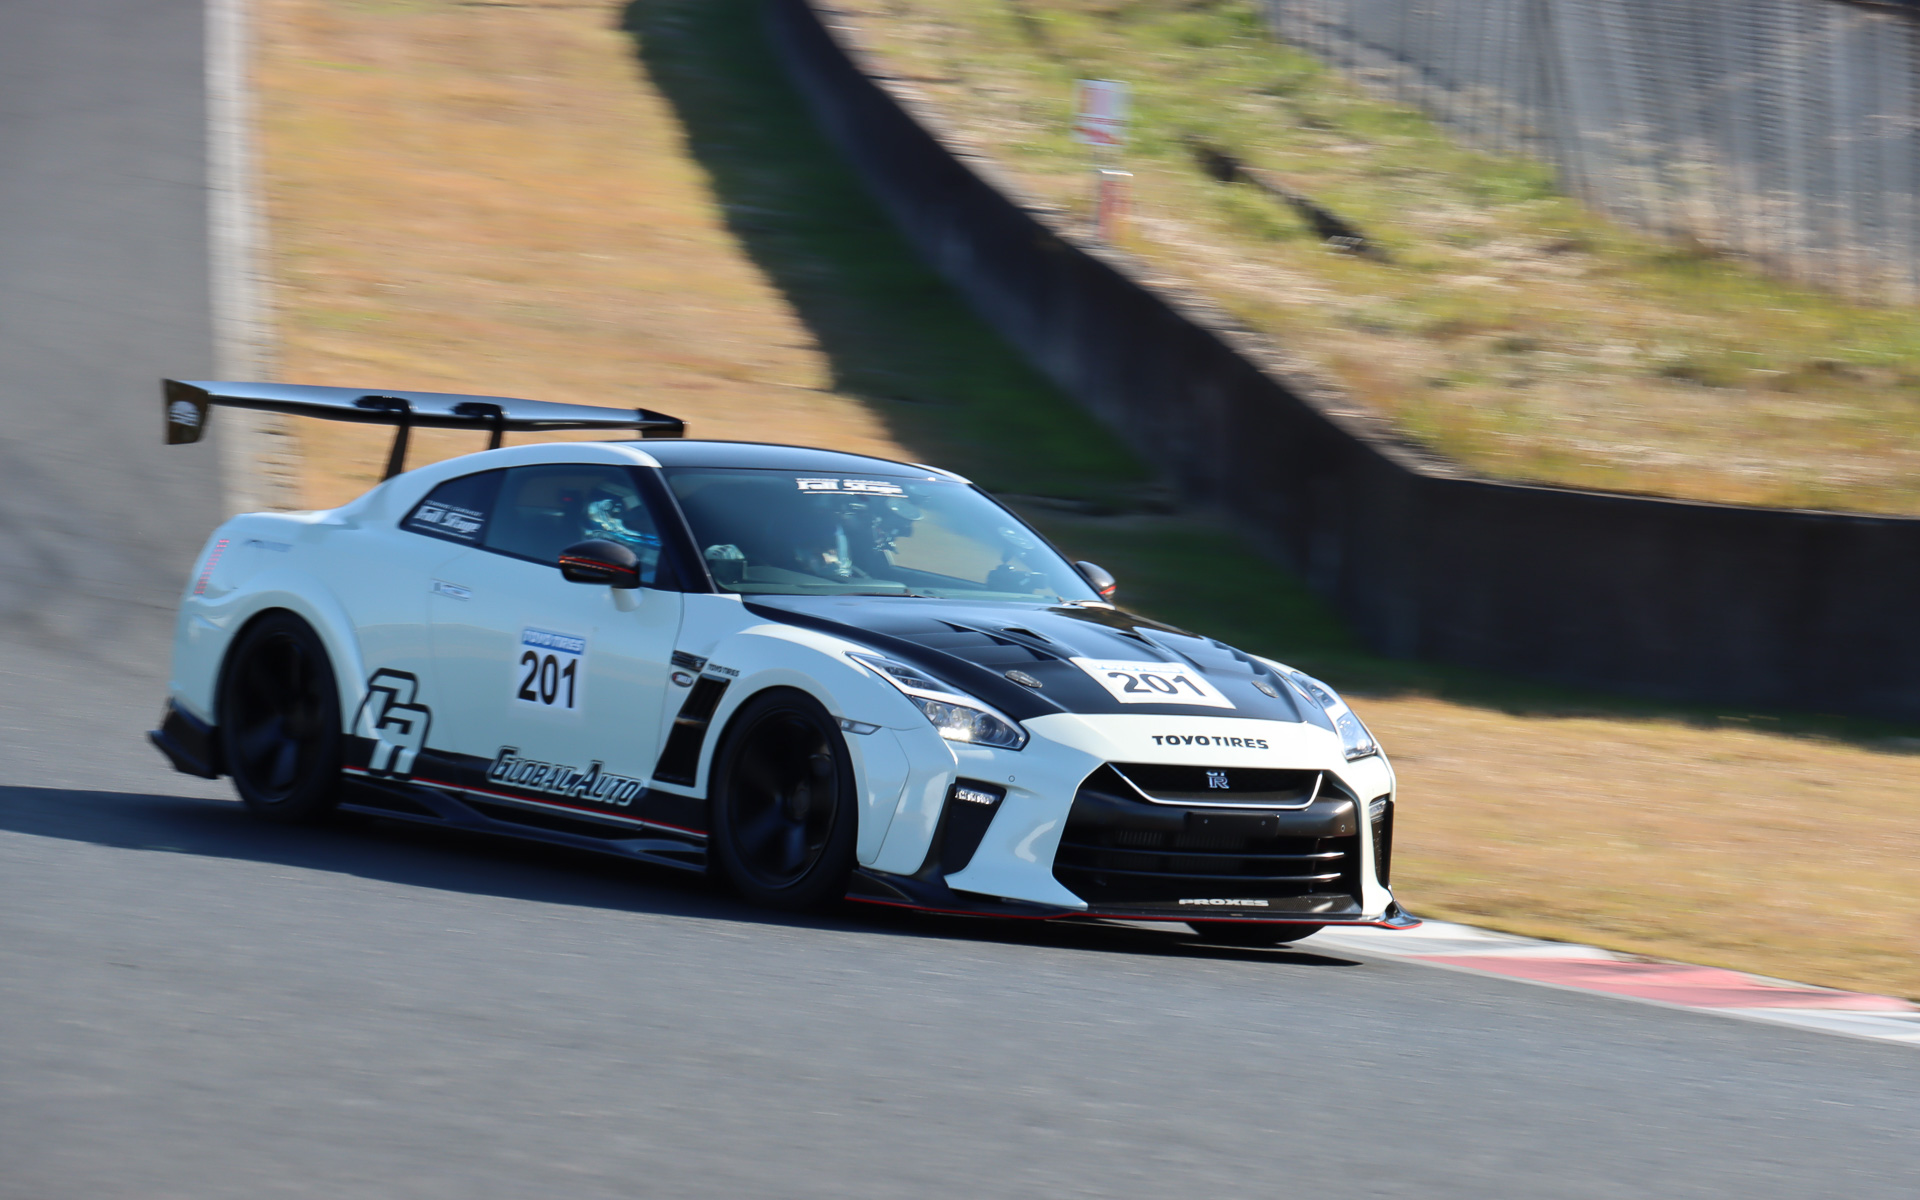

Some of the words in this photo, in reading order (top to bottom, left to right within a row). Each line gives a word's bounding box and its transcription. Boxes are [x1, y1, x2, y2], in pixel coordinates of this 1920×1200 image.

[517, 650, 578, 709] 201
[1107, 672, 1207, 697] 201
[488, 746, 574, 794] GLOBAL
[568, 760, 643, 806] AUTO
[1178, 898, 1269, 907] PROXES
